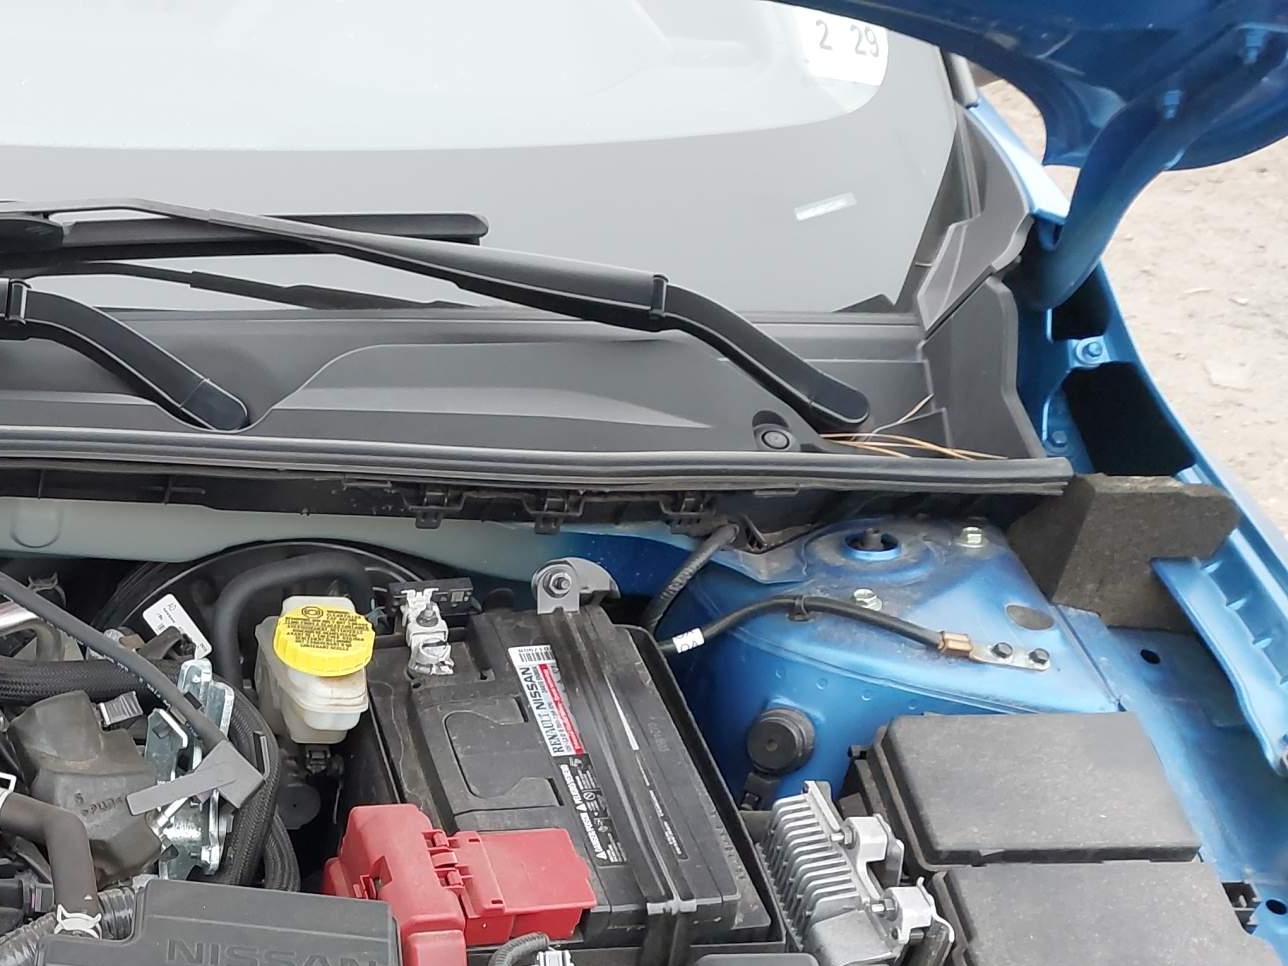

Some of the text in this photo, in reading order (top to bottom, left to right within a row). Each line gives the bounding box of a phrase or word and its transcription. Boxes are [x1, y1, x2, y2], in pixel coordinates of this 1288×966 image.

[815, 19, 879, 58] 2 29
[519, 666, 547, 711] NISSAN
